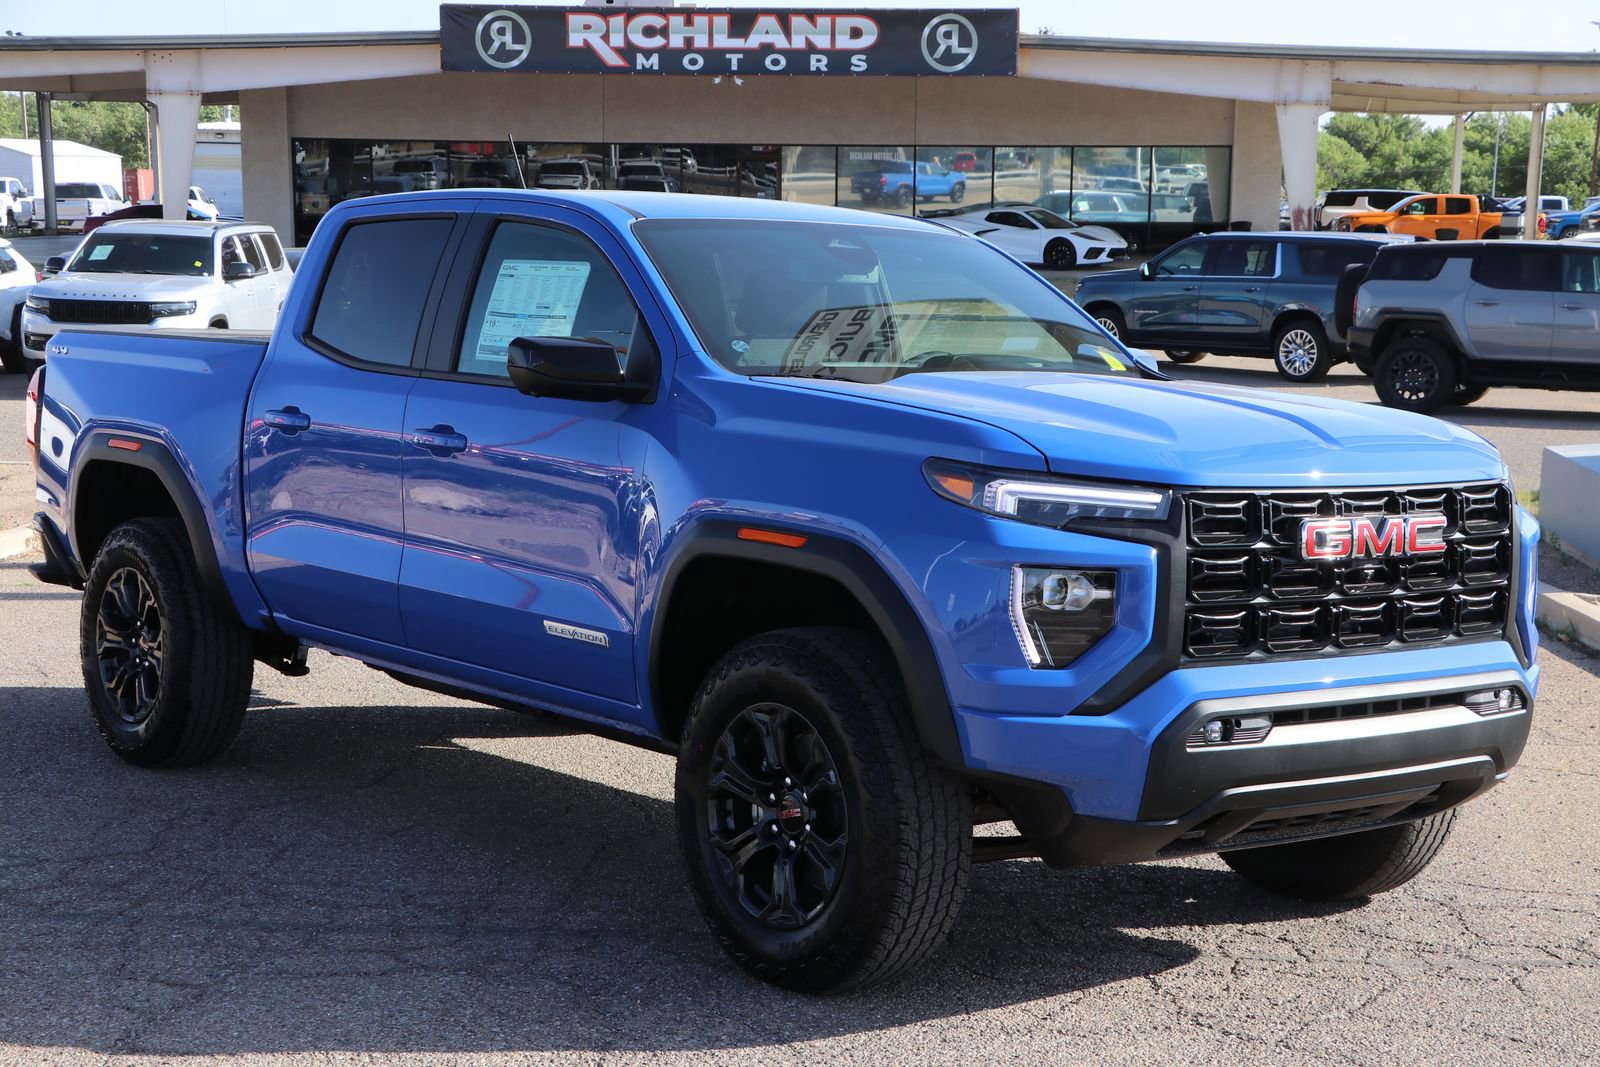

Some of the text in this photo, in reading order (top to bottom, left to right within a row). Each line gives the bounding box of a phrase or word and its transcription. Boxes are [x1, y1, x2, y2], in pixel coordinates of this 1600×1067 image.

[565, 12, 880, 67] RICHLAND
[635, 52, 868, 71] MOTORS
[1300, 516, 1447, 560] GMC
[547, 625, 603, 643] ELEVATION
